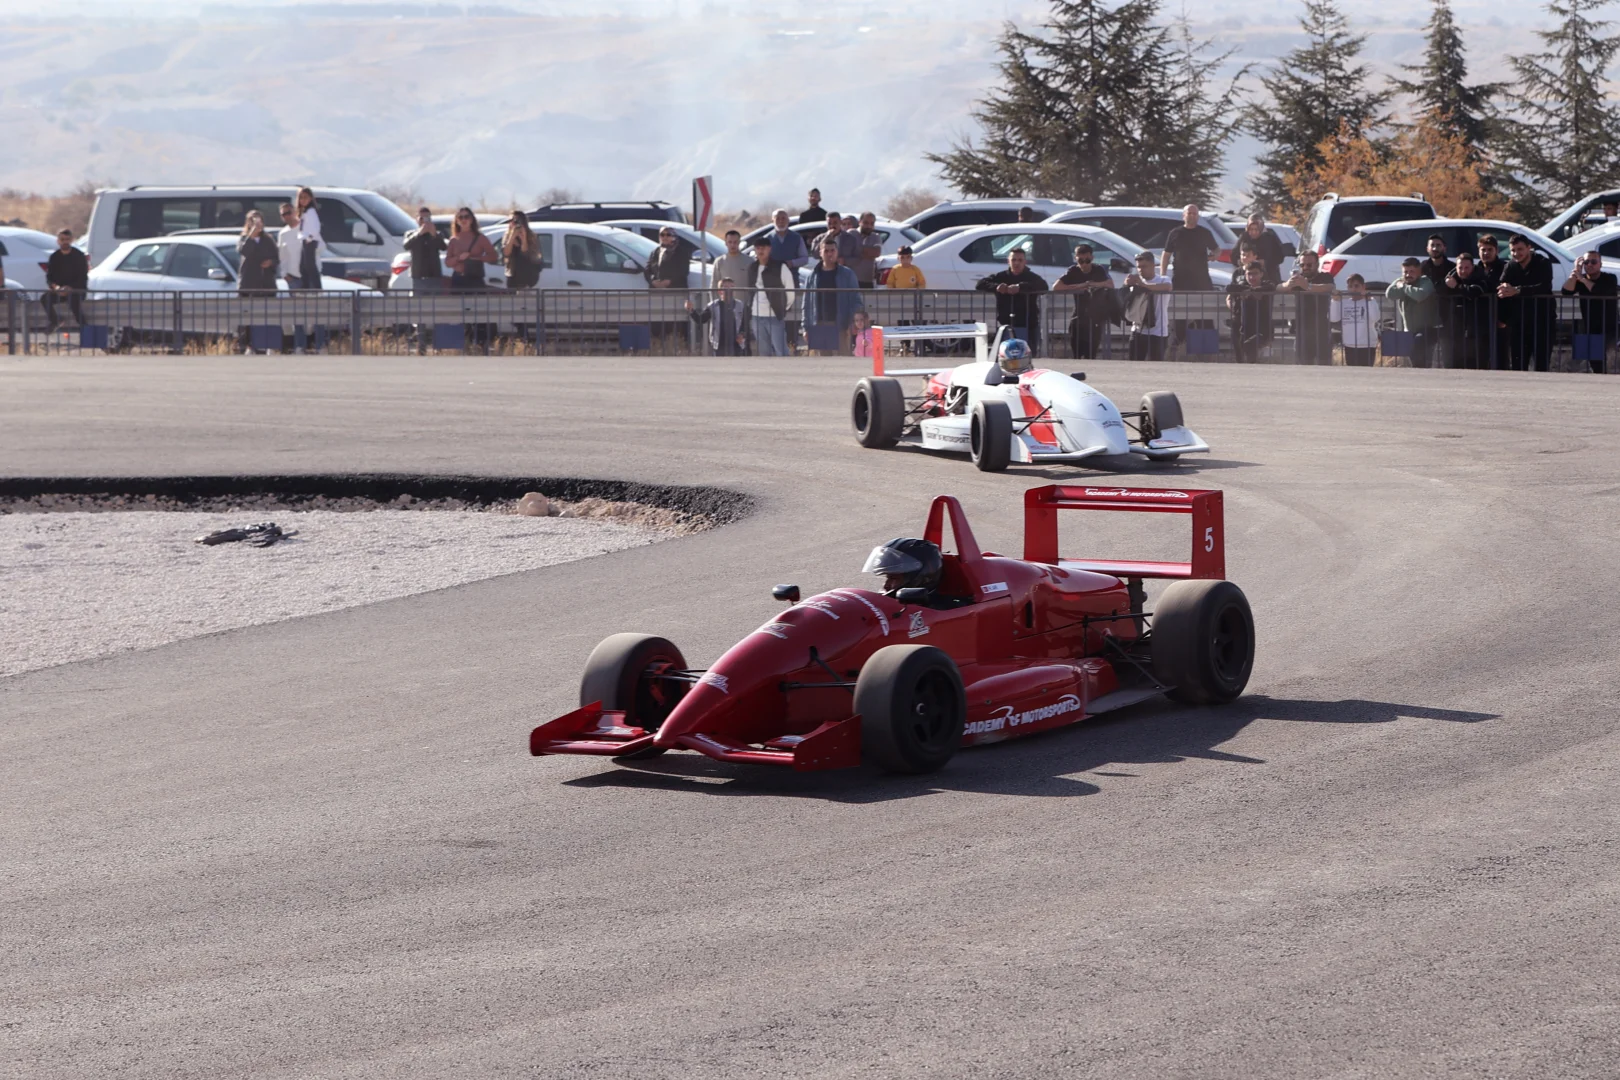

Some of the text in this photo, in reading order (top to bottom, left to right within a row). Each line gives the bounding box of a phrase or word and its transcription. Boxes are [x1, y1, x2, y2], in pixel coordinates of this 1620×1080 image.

[1204, 526, 1214, 553] 5
[963, 717, 1007, 736] CADEMY
[1021, 696, 1080, 725] MOTORSPORTS
